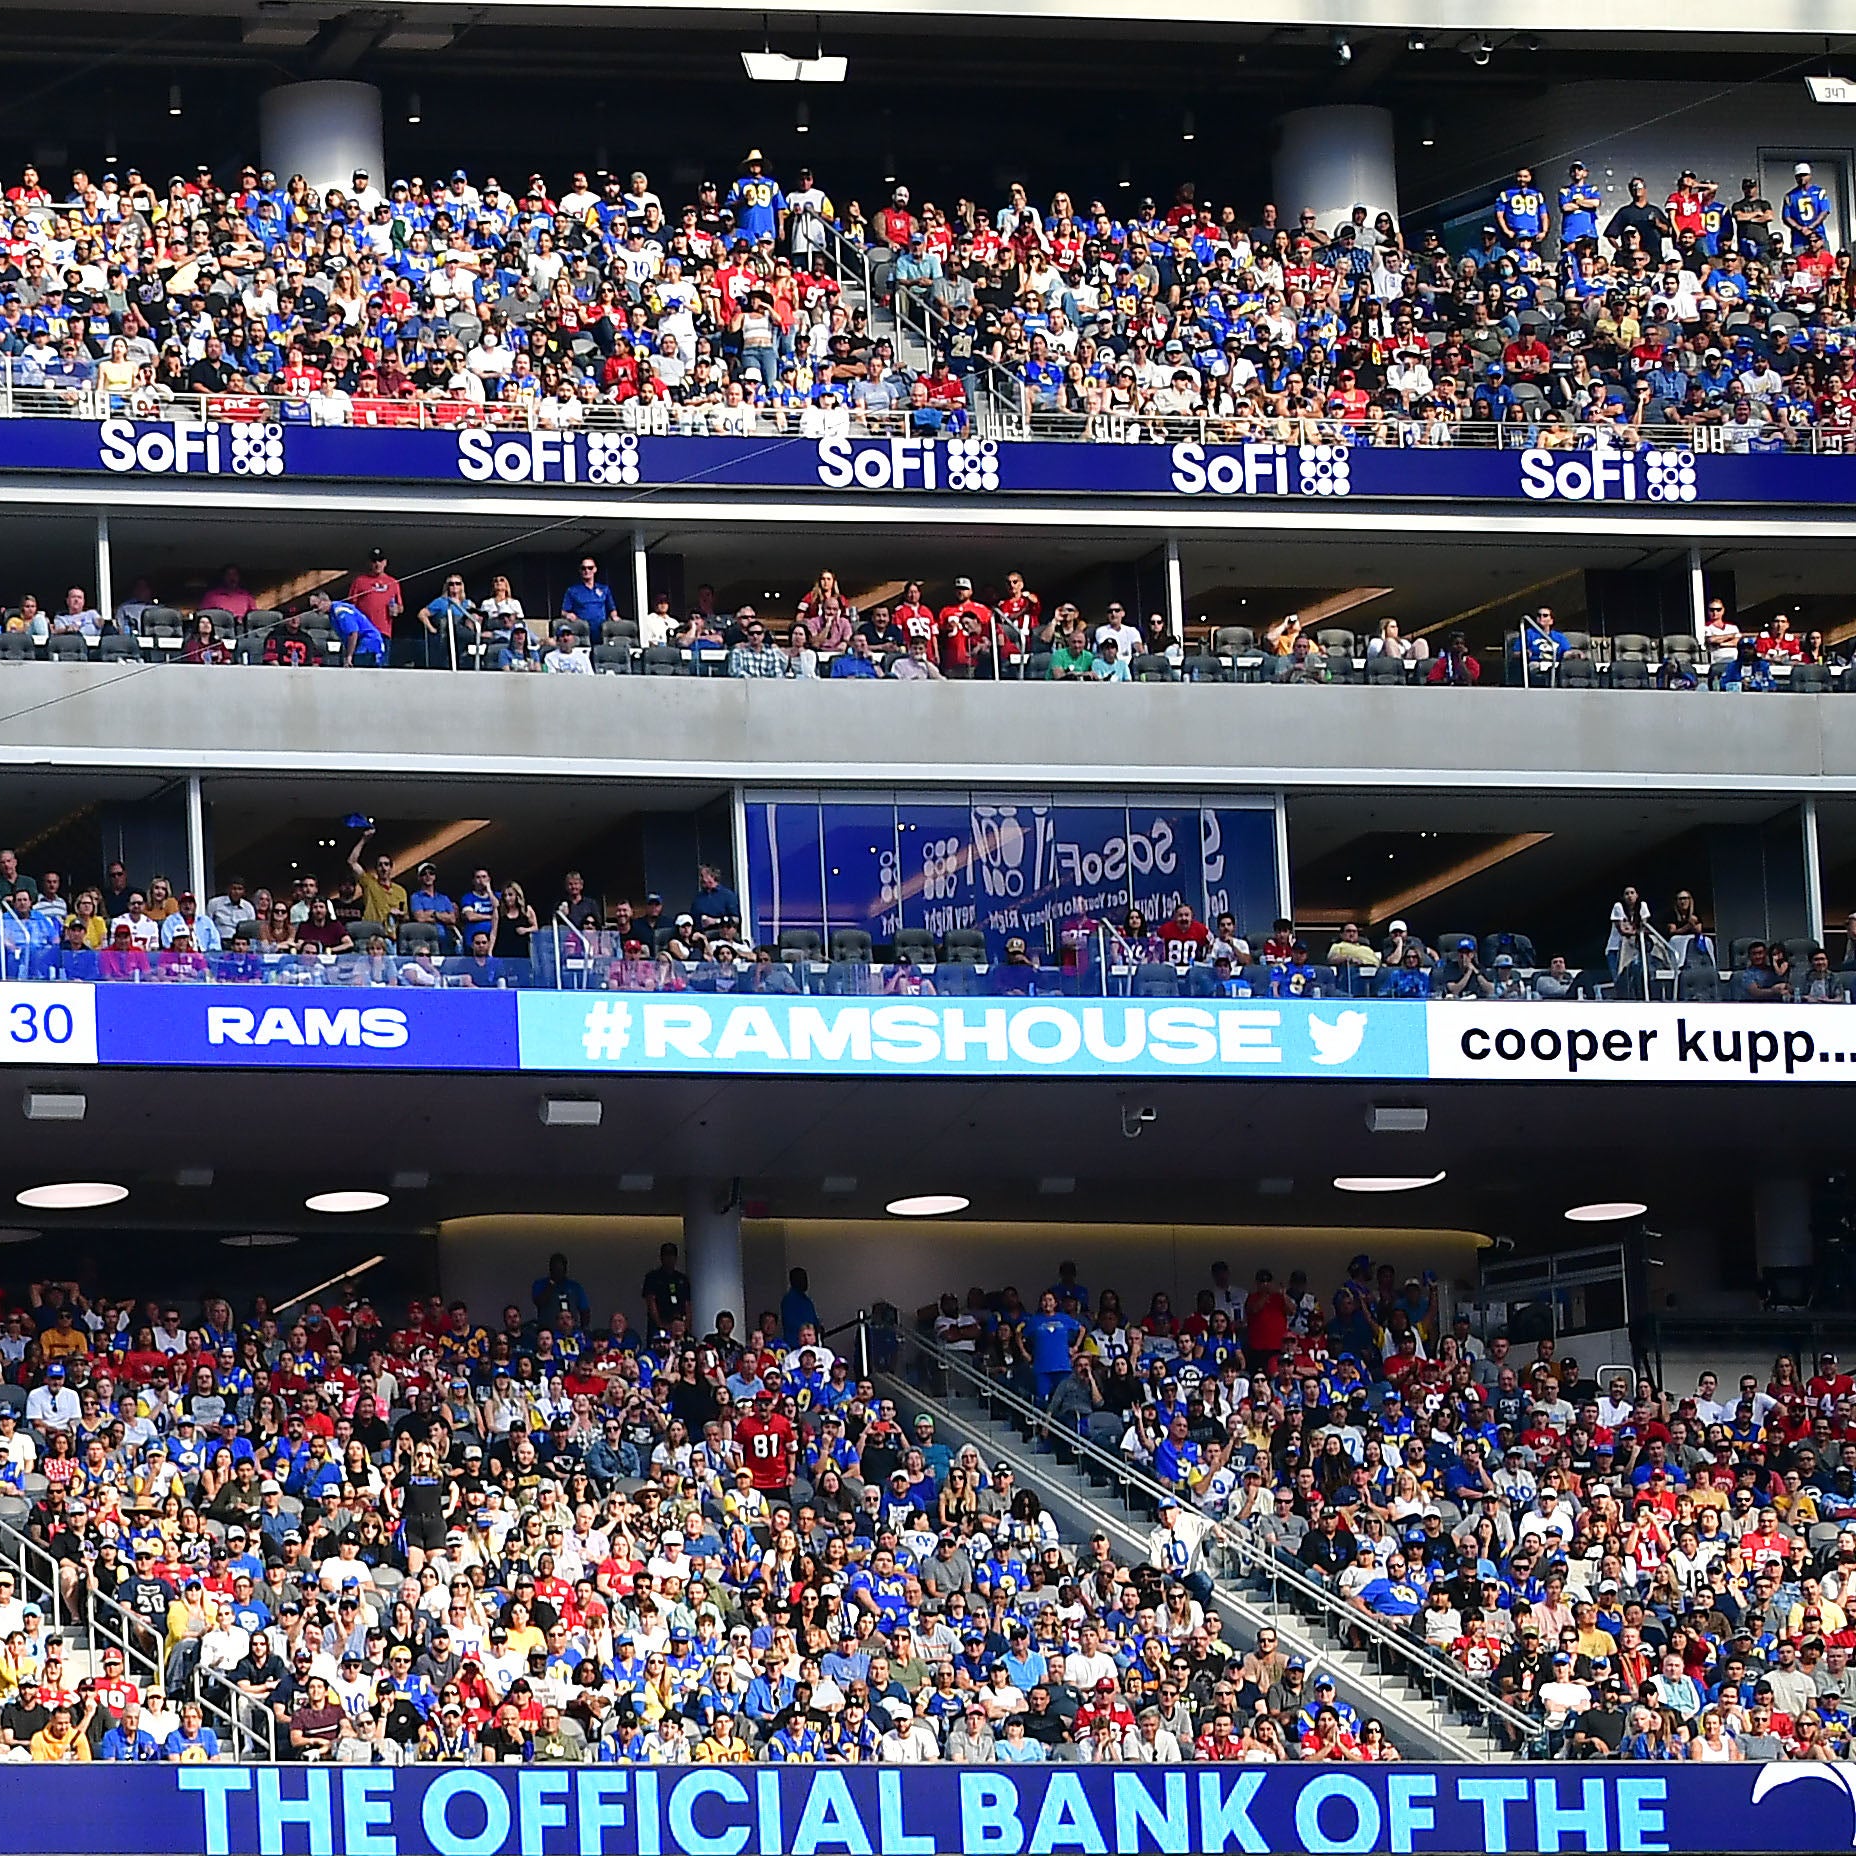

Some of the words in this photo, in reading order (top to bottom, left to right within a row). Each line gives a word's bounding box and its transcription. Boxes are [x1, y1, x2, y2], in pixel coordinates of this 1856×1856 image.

[99, 419, 220, 474] SoFi
[458, 428, 578, 483] SoFi
[818, 438, 936, 490] SoFi
[1171, 444, 1287, 497] SoFi
[1521, 450, 1635, 502] SoFi
[11, 1004, 73, 1043] 30
[208, 1007, 408, 1047] RAMS
[584, 1002, 1284, 1066] #RAMSHOUSE
[1461, 1028, 1657, 1072] cooper
[1677, 1019, 1856, 1074] kupp...
[754, 1435, 779, 1458] 81
[961, 1771, 1271, 1856] BANK
[1296, 1774, 1436, 1853] OF
[1458, 1778, 1669, 1855] THE
